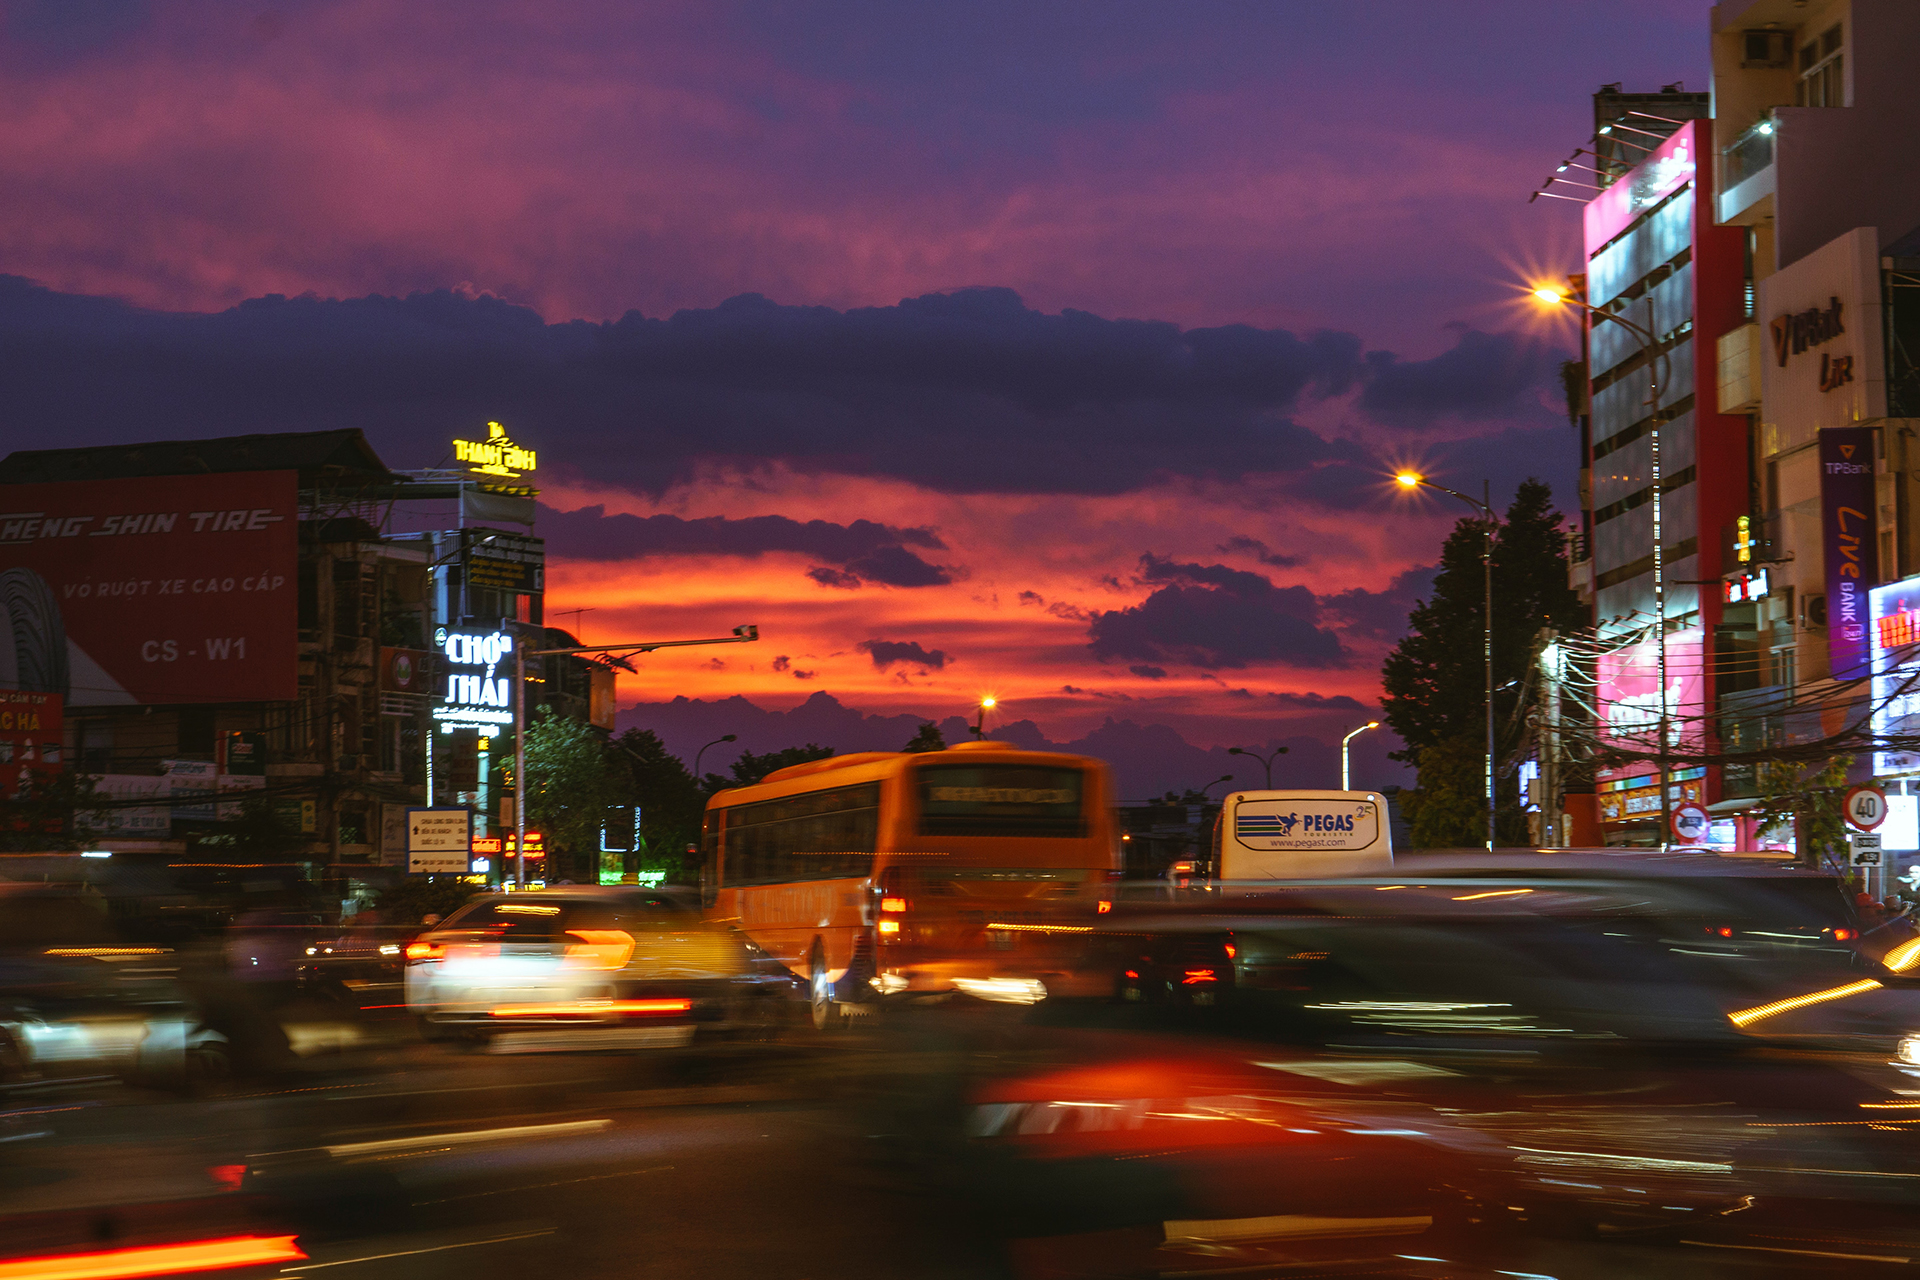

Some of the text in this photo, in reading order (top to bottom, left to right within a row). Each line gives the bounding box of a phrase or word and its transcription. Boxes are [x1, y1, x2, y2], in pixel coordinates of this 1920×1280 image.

[1825, 462, 1872, 475] TPBank
[89, 512, 180, 537] SHIN
[188, 508, 285, 533] TIRE
[1838, 506, 1868, 622] Live BANK
[97, 577, 152, 601] RUỘT
[159, 578, 187, 595] XE
[192, 577, 235, 594] CAO
[242, 568, 286, 592] CẤP
[141, 639, 179, 663] CS
[205, 637, 247, 661] W1
[1855, 797, 1876, 818] 40
[1304, 814, 1354, 832] PEGAS
[1270, 838, 1346, 848] www.pegast.com
